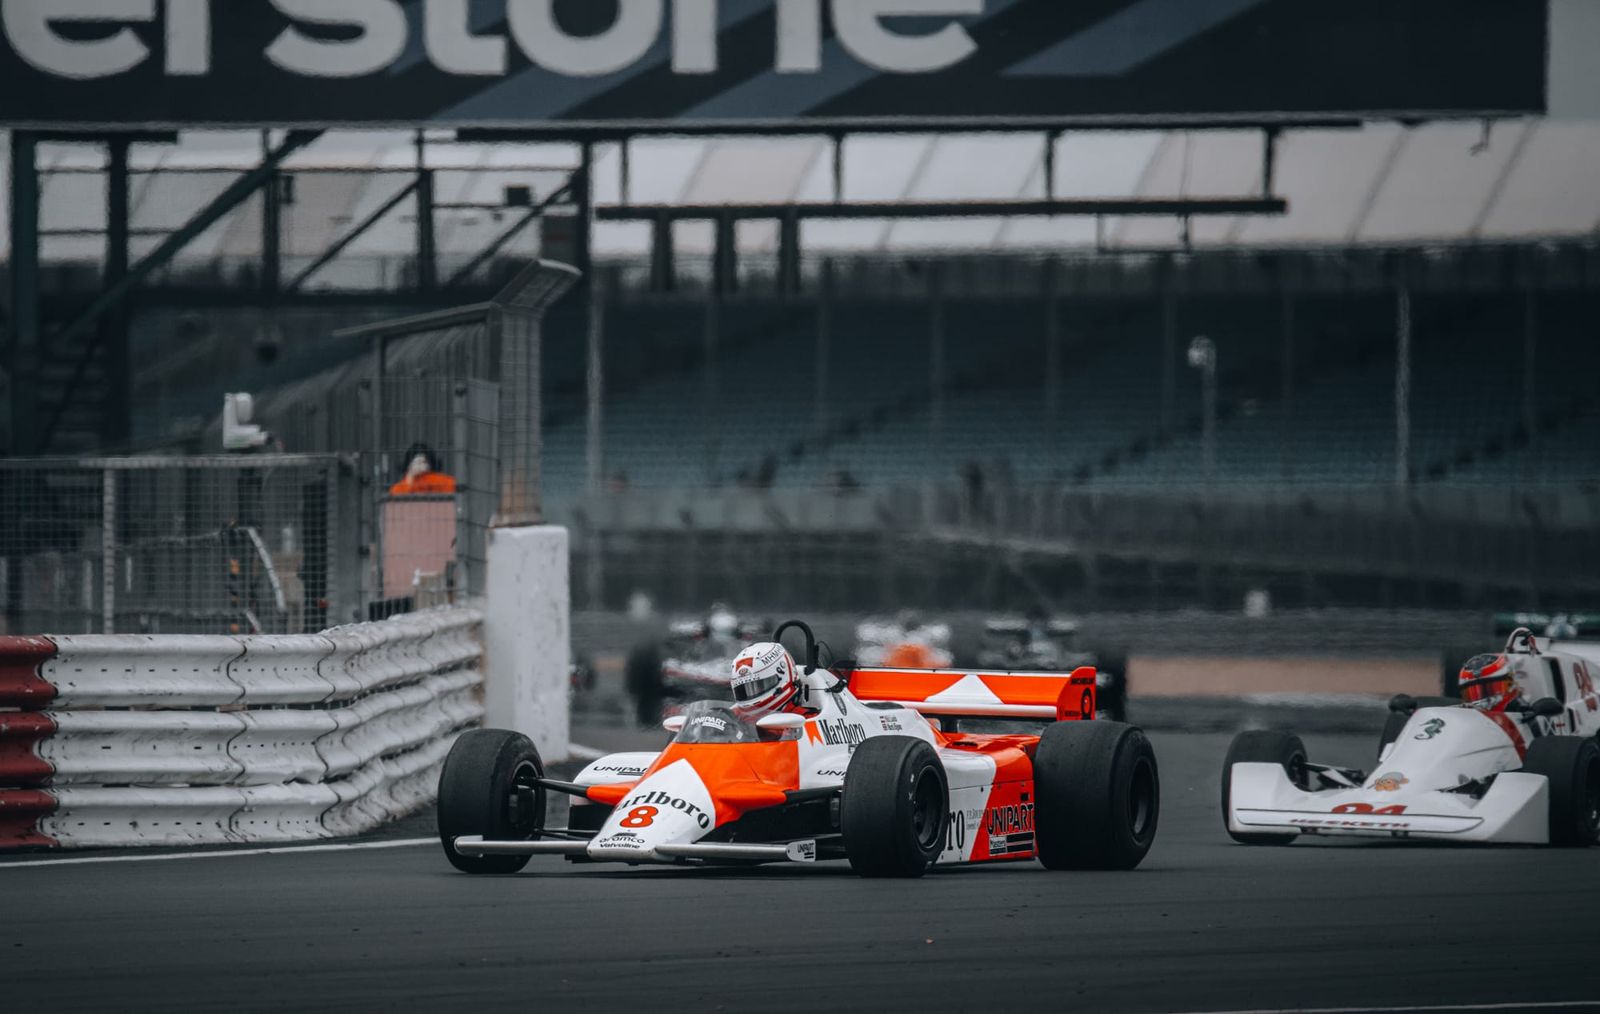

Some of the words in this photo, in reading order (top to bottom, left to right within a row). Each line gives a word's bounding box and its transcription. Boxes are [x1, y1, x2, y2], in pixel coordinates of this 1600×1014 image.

[690, 715, 727, 728] UNIPART
[818, 719, 866, 746] Marlboro
[619, 806, 658, 828] 8
[986, 803, 1034, 834] UNIPART
[1289, 818, 1411, 828] HESKETH
[599, 836, 645, 844] aramco
